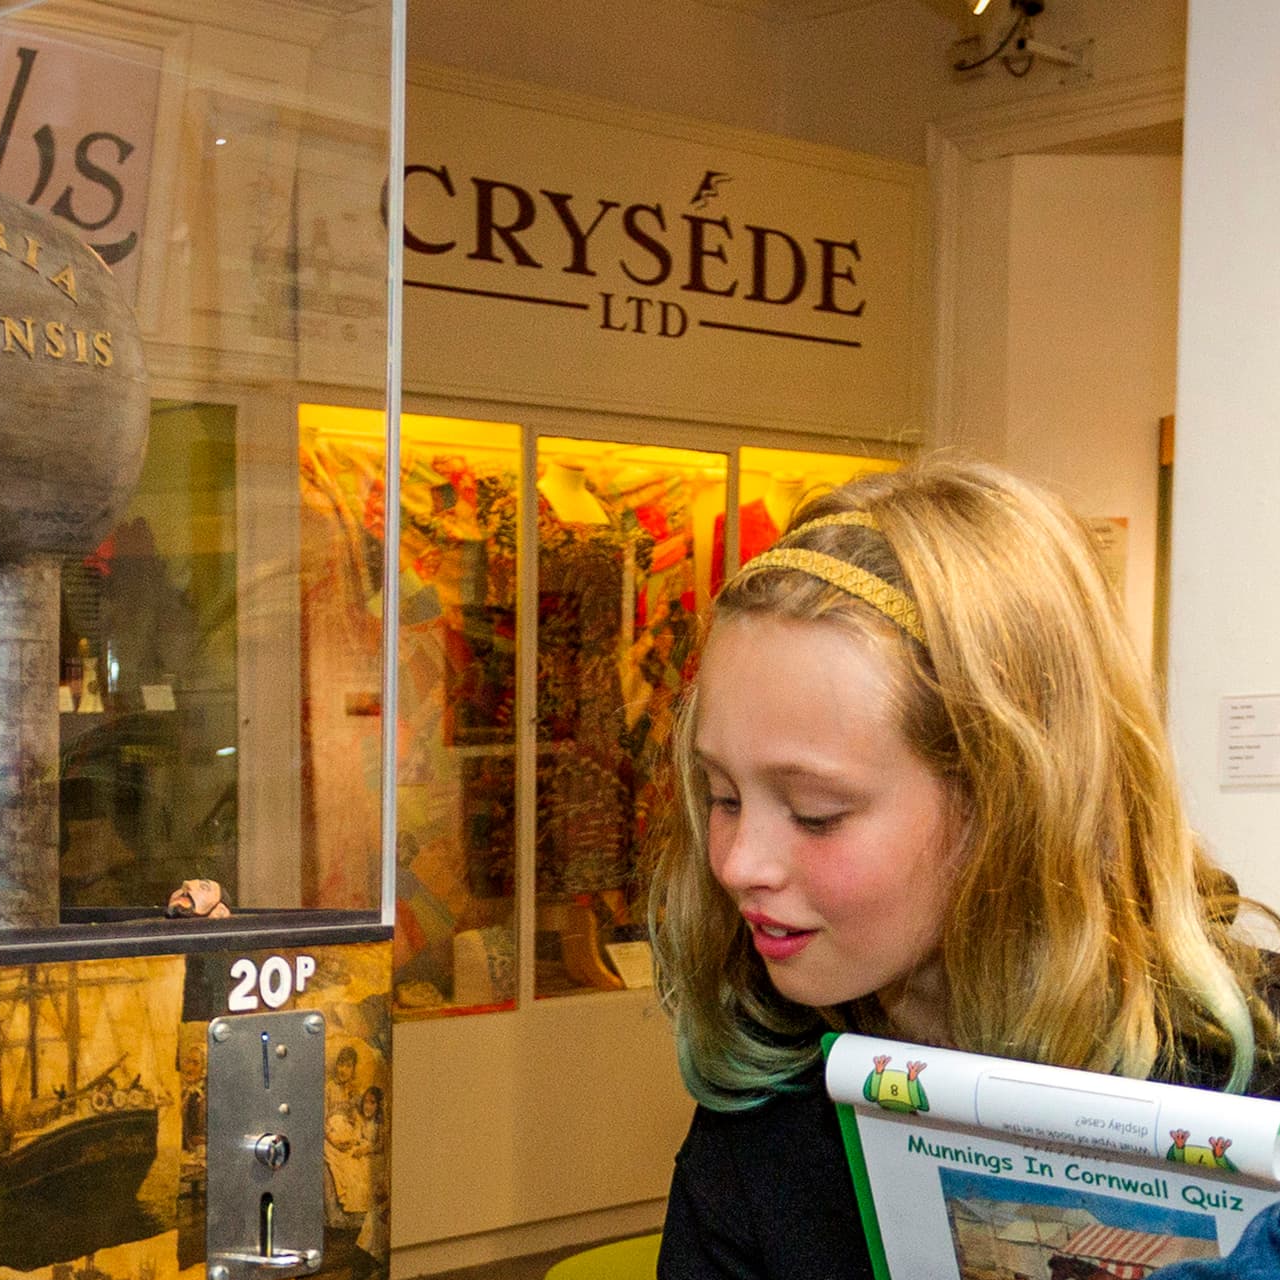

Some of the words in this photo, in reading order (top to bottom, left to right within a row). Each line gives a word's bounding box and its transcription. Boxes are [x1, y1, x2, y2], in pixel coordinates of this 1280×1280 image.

[599, 291, 689, 338] LTD
[228, 955, 317, 1012] 20P
[1075, 1115, 1106, 1129] case?
[1108, 1119, 1149, 1138] display
[908, 1134, 1014, 1174] Munnings
[1023, 1154, 1054, 1178] In
[1064, 1163, 1169, 1200] Cornwall
[1181, 1184, 1245, 1212] Quiz
